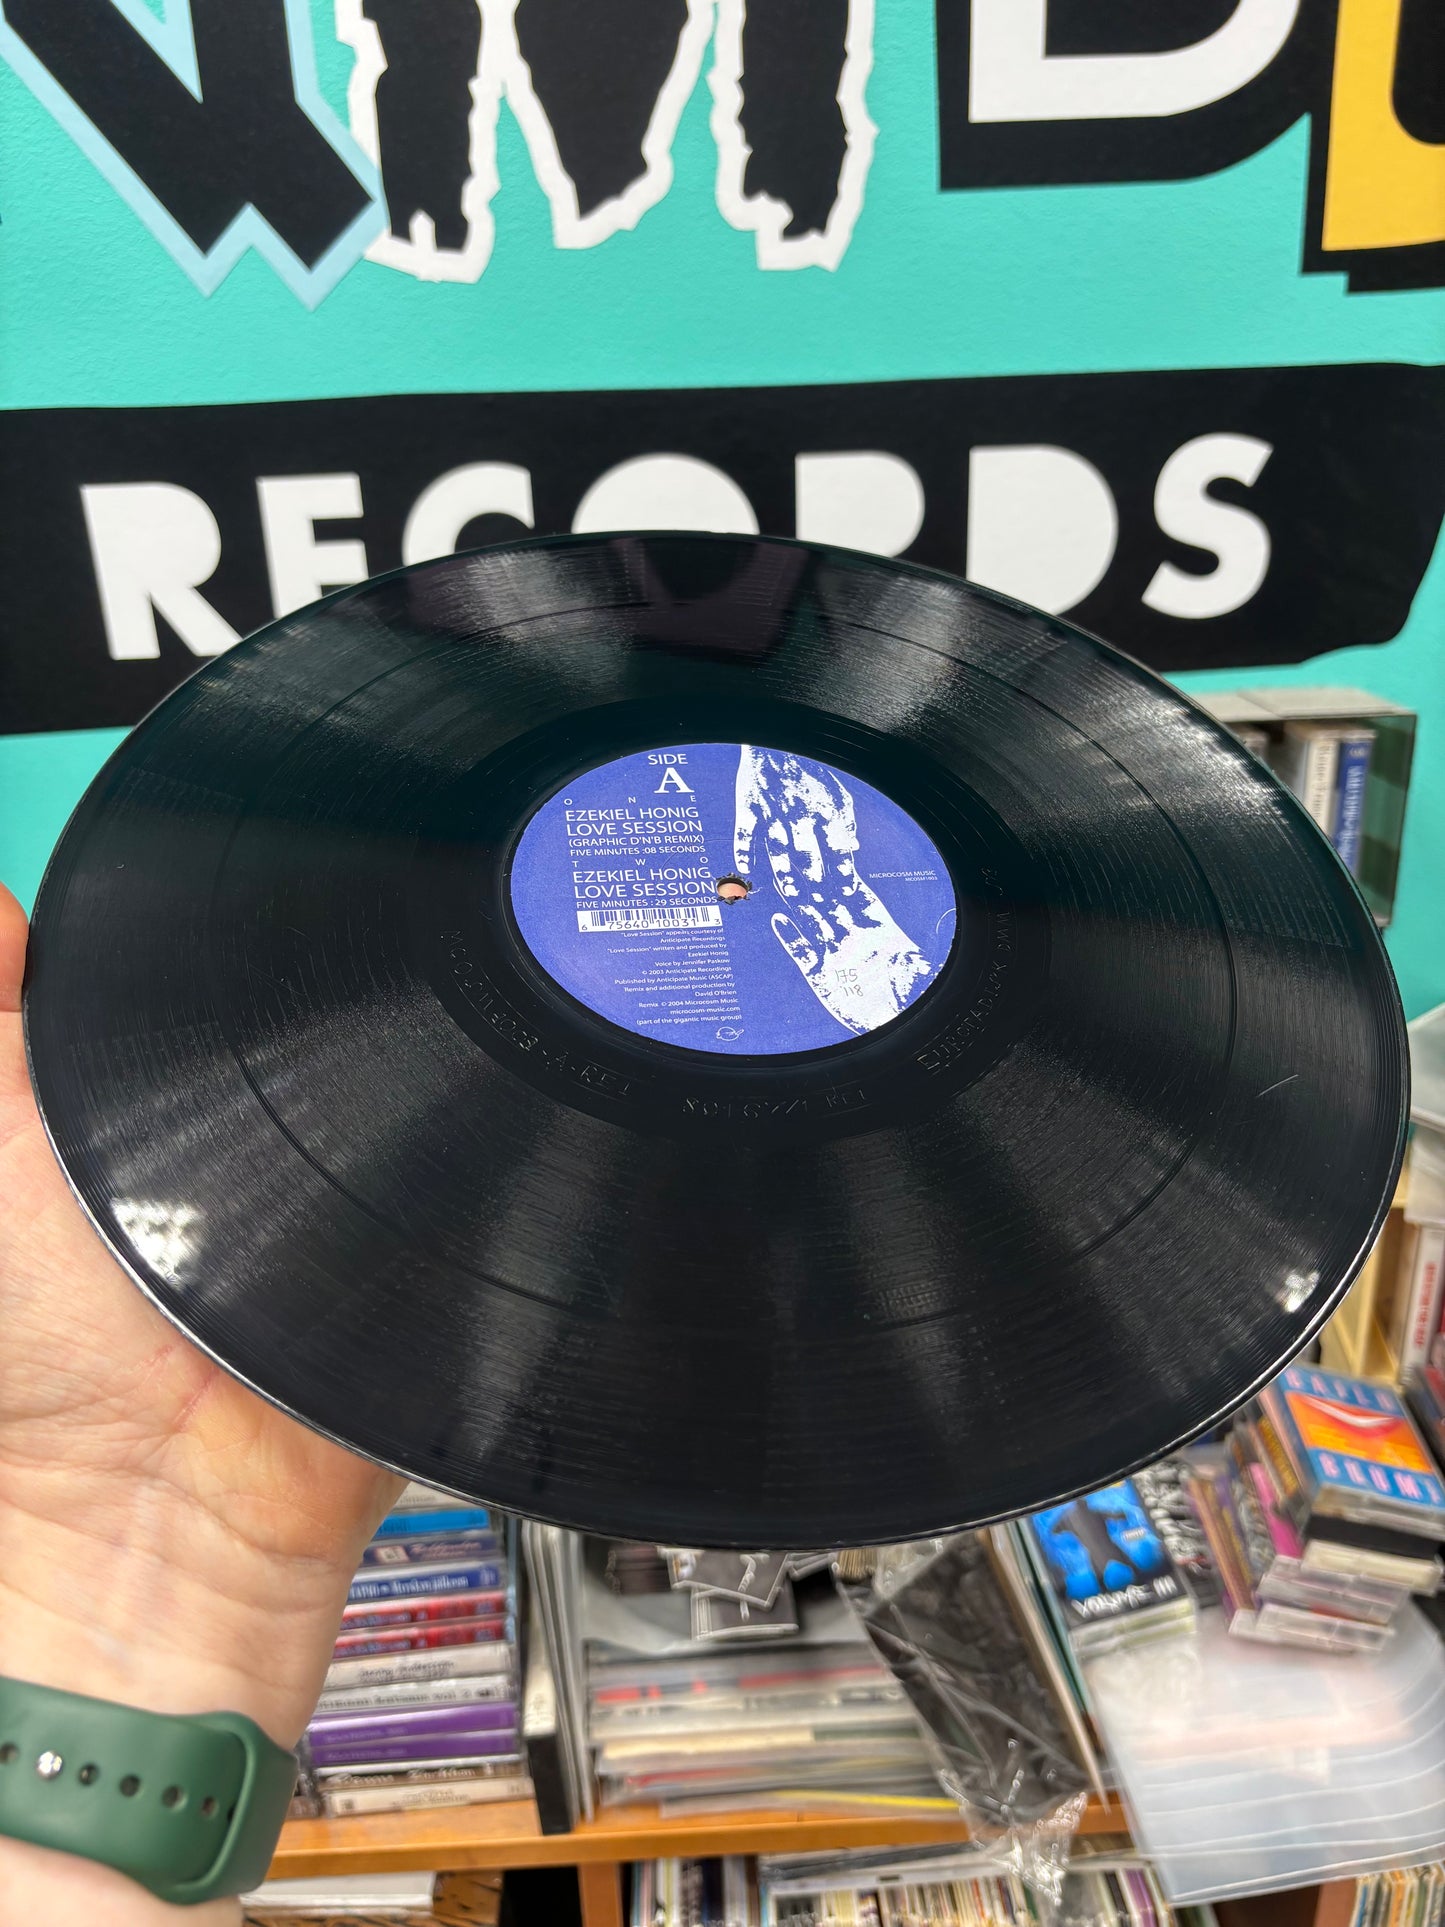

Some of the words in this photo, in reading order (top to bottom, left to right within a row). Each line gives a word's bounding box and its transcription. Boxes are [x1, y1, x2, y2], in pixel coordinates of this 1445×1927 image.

[648, 754, 688, 765] SIDE
[654, 767, 695, 793] A
[565, 808, 636, 822] EZEKIEL
[639, 806, 699, 819] HONIG
[566, 822, 618, 837] LOVE
[622, 820, 703, 835] SESSION
[568, 837, 628, 848] (GRAPHIC
[630, 835, 662, 845] D'N'B
[664, 834, 705, 844] REMIX)
[570, 849, 592, 857] FIVE
[594, 847, 640, 855] MINUTES
[642, 846, 657, 854] :08
[659, 845, 706, 853] SECONDS
[573, 869, 646, 883] EZEKIEL
[649, 867, 711, 881] HONIG
[869, 871, 913, 879] MICROCOSM
[574, 884, 627, 899] LOVE
[632, 881, 717, 897] SESSION
[576, 901, 599, 909] FIVE
[601, 899, 648, 908] MINUTES
[669, 896, 718, 905] SECONDS
[609, 919, 649, 930] 75640
[656, 918, 697, 928] 10031
